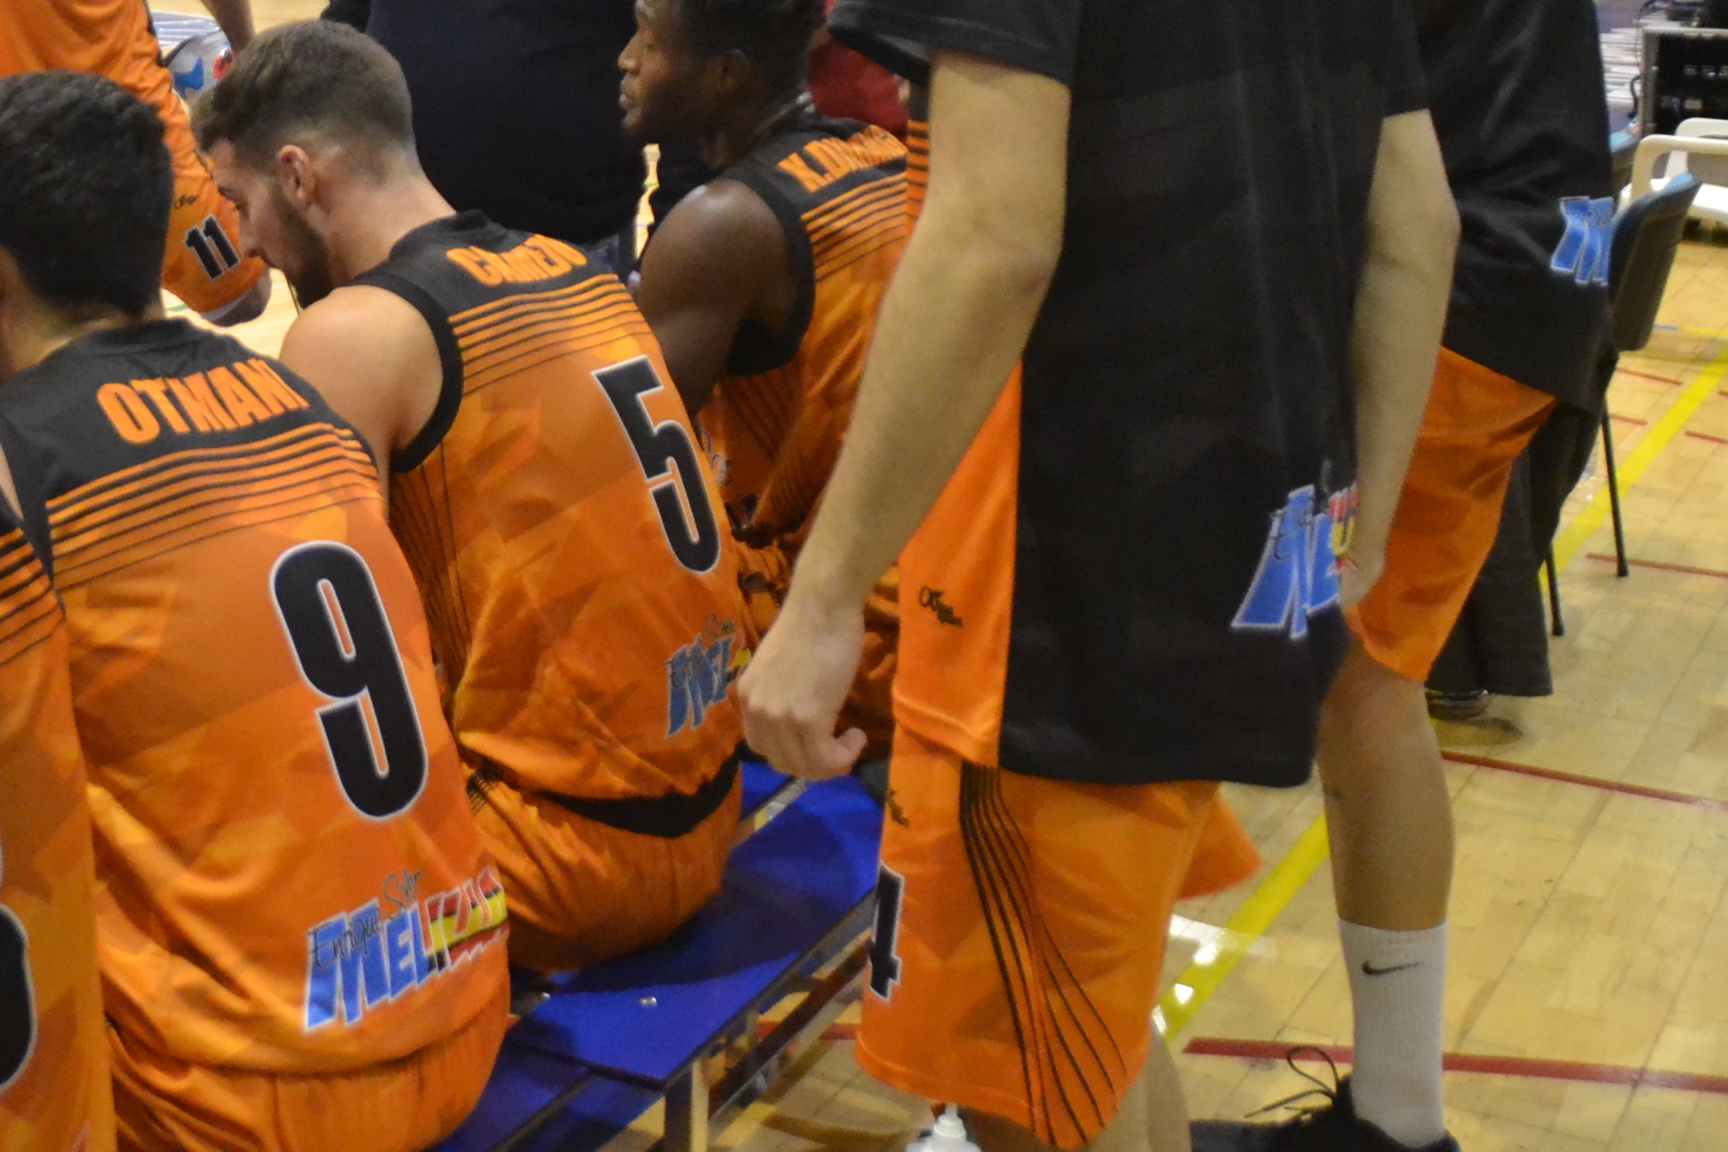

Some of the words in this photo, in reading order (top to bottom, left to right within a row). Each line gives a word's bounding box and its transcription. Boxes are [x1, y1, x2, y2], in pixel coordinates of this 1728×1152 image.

[184, 213, 241, 280] 11
[590, 353, 722, 575] 5
[270, 539, 429, 822] 9
